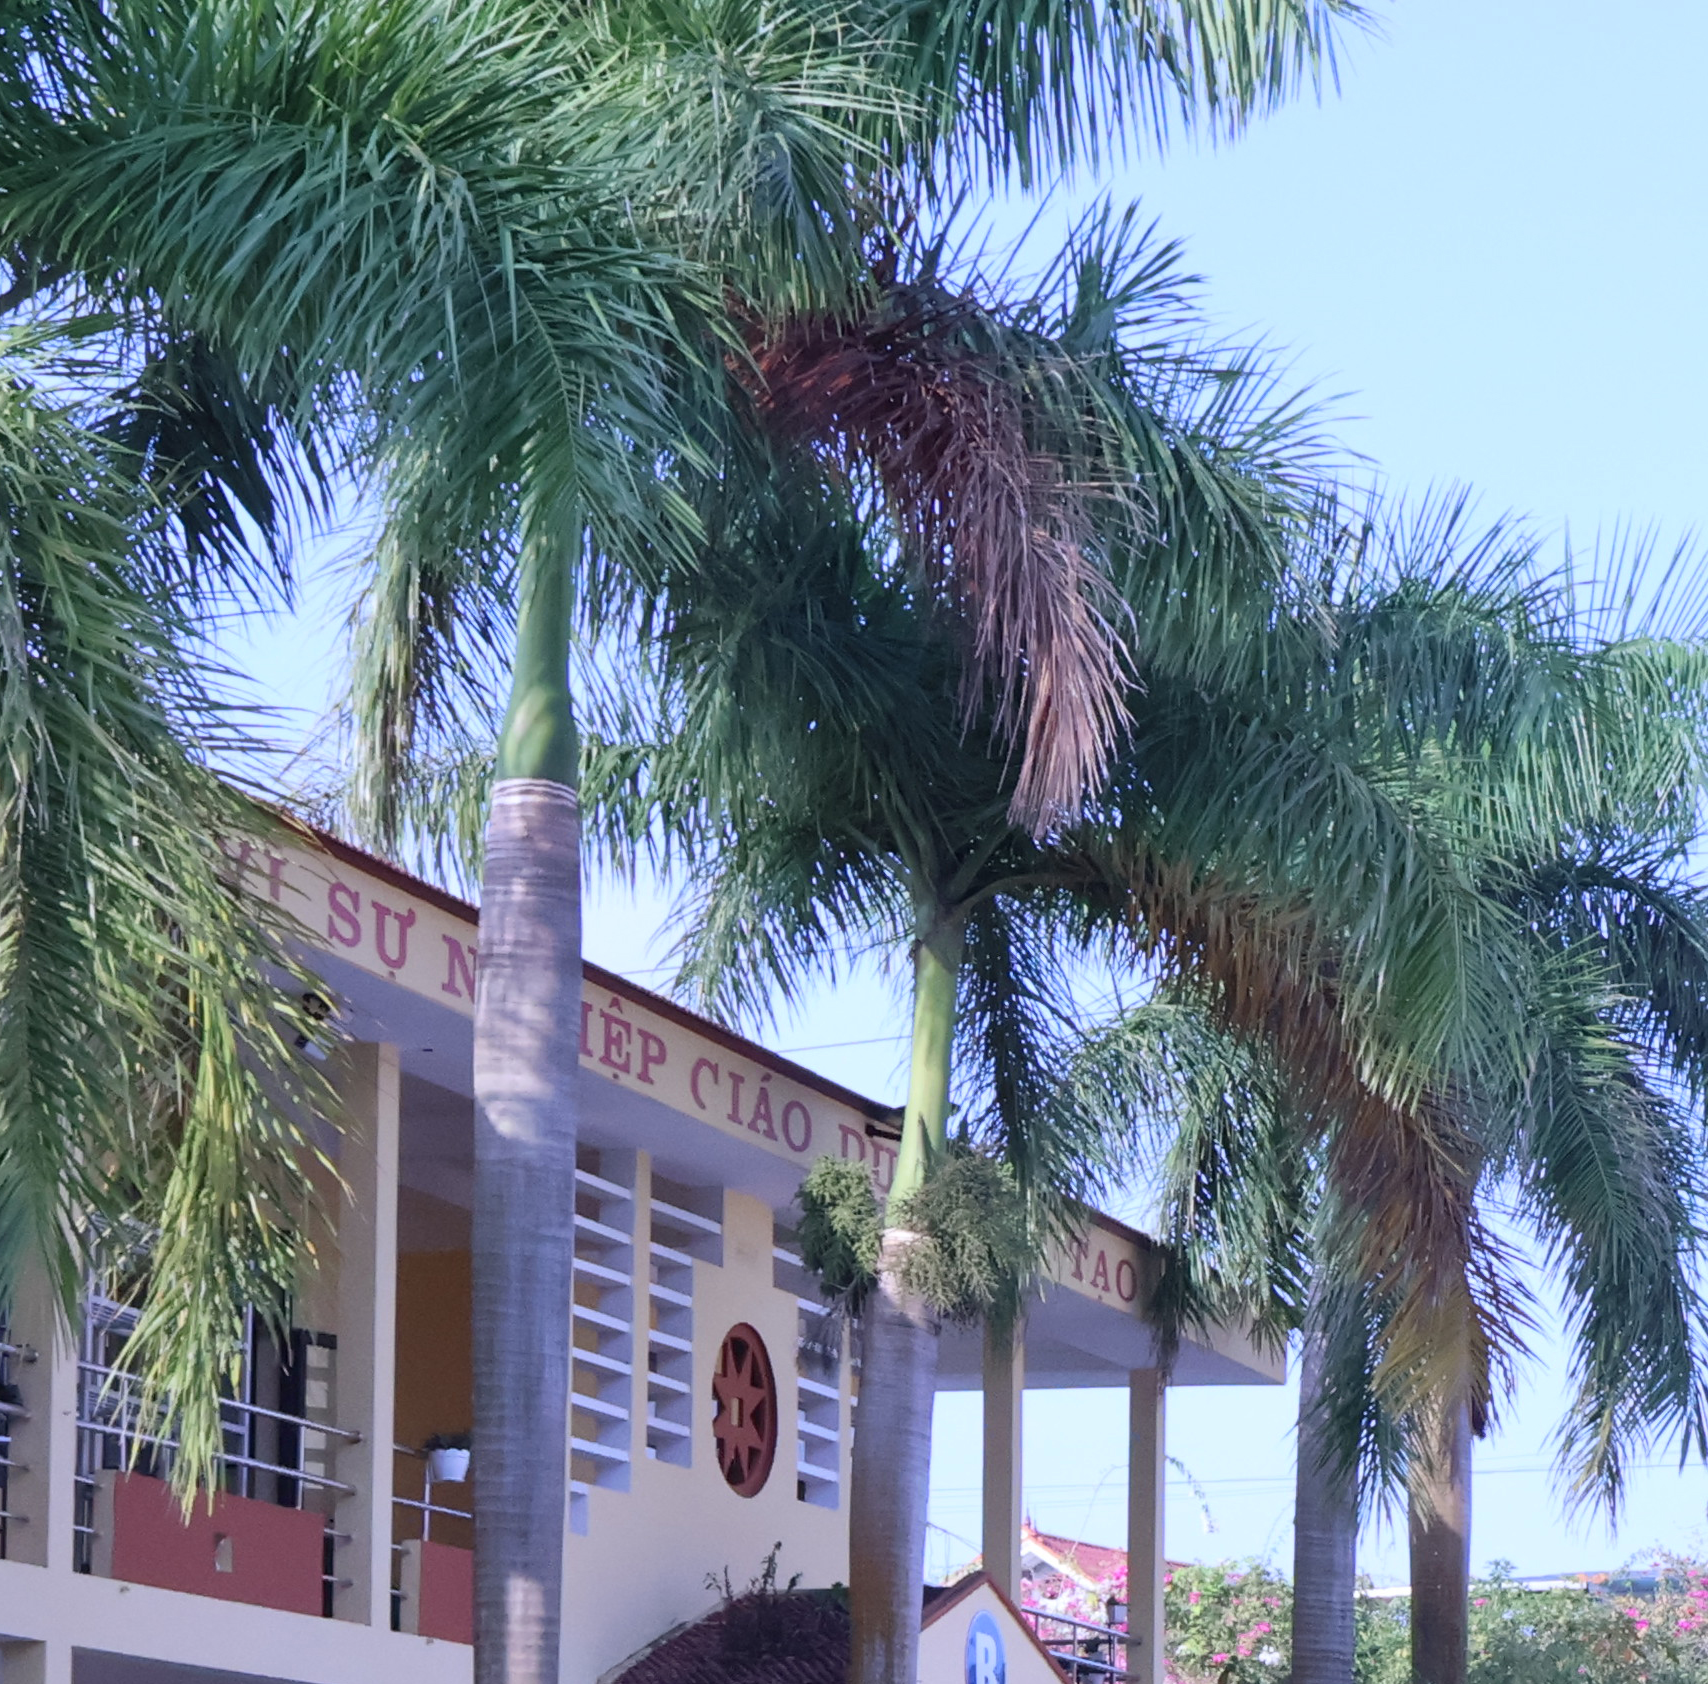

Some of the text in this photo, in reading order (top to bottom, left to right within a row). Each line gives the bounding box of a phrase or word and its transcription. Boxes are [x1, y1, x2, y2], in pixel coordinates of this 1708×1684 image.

[328, 881, 417, 980] SỰ
[442, 934, 668, 1085] NIỆP
[1068, 1238, 1137, 1302] TẠO
